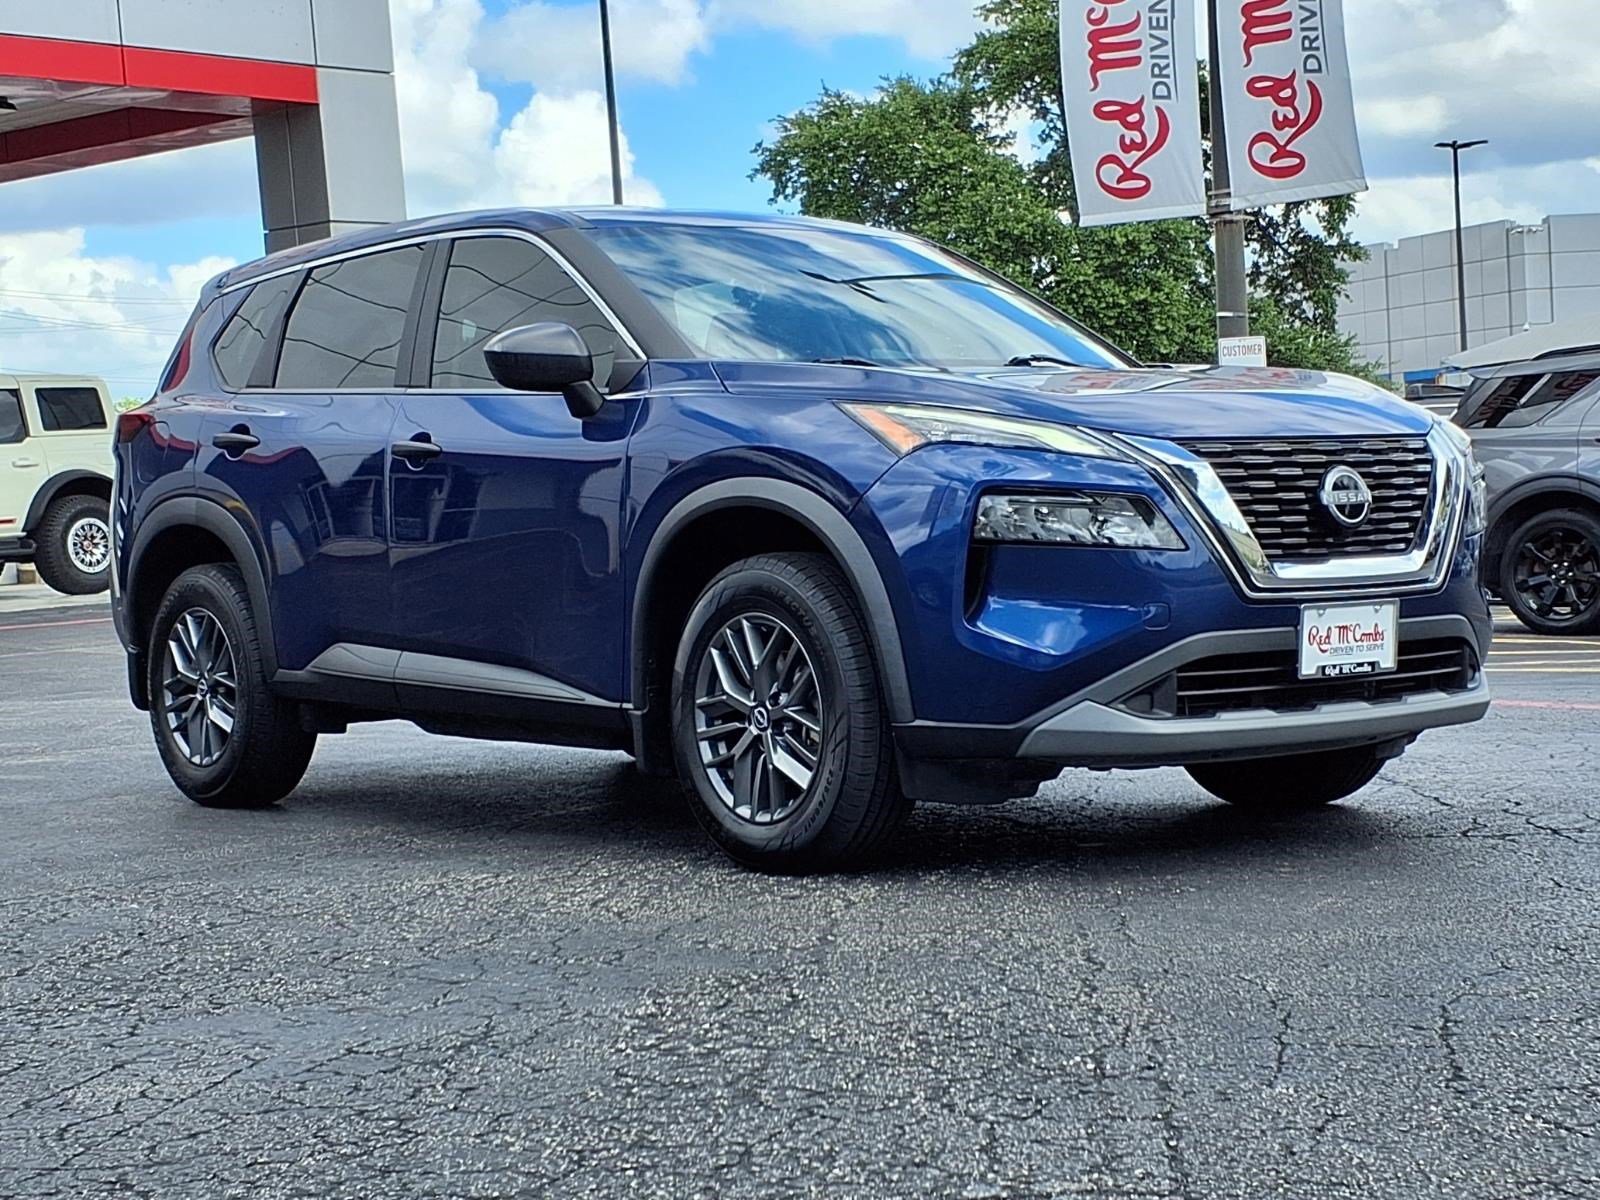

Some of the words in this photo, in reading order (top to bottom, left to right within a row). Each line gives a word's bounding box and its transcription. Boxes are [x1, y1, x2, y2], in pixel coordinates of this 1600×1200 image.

[1085, 0, 1143, 92] Mc
[1147, 0, 1172, 100] DRIVEN
[1298, 0, 1323, 74] DRIV
[1092, 95, 1170, 200] Red
[1246, 69, 1323, 178] Red
[1222, 343, 1263, 357] CUSTOMER
[1322, 491, 1370, 505] NISSAN
[1308, 625, 1332, 653] Red
[1334, 622, 1385, 645] McCombs
[1329, 645, 1354, 655] DRIVEN
[1355, 645, 1365, 653] TO
[1365, 643, 1385, 652] SERVE
[1325, 664, 1340, 676] Red
